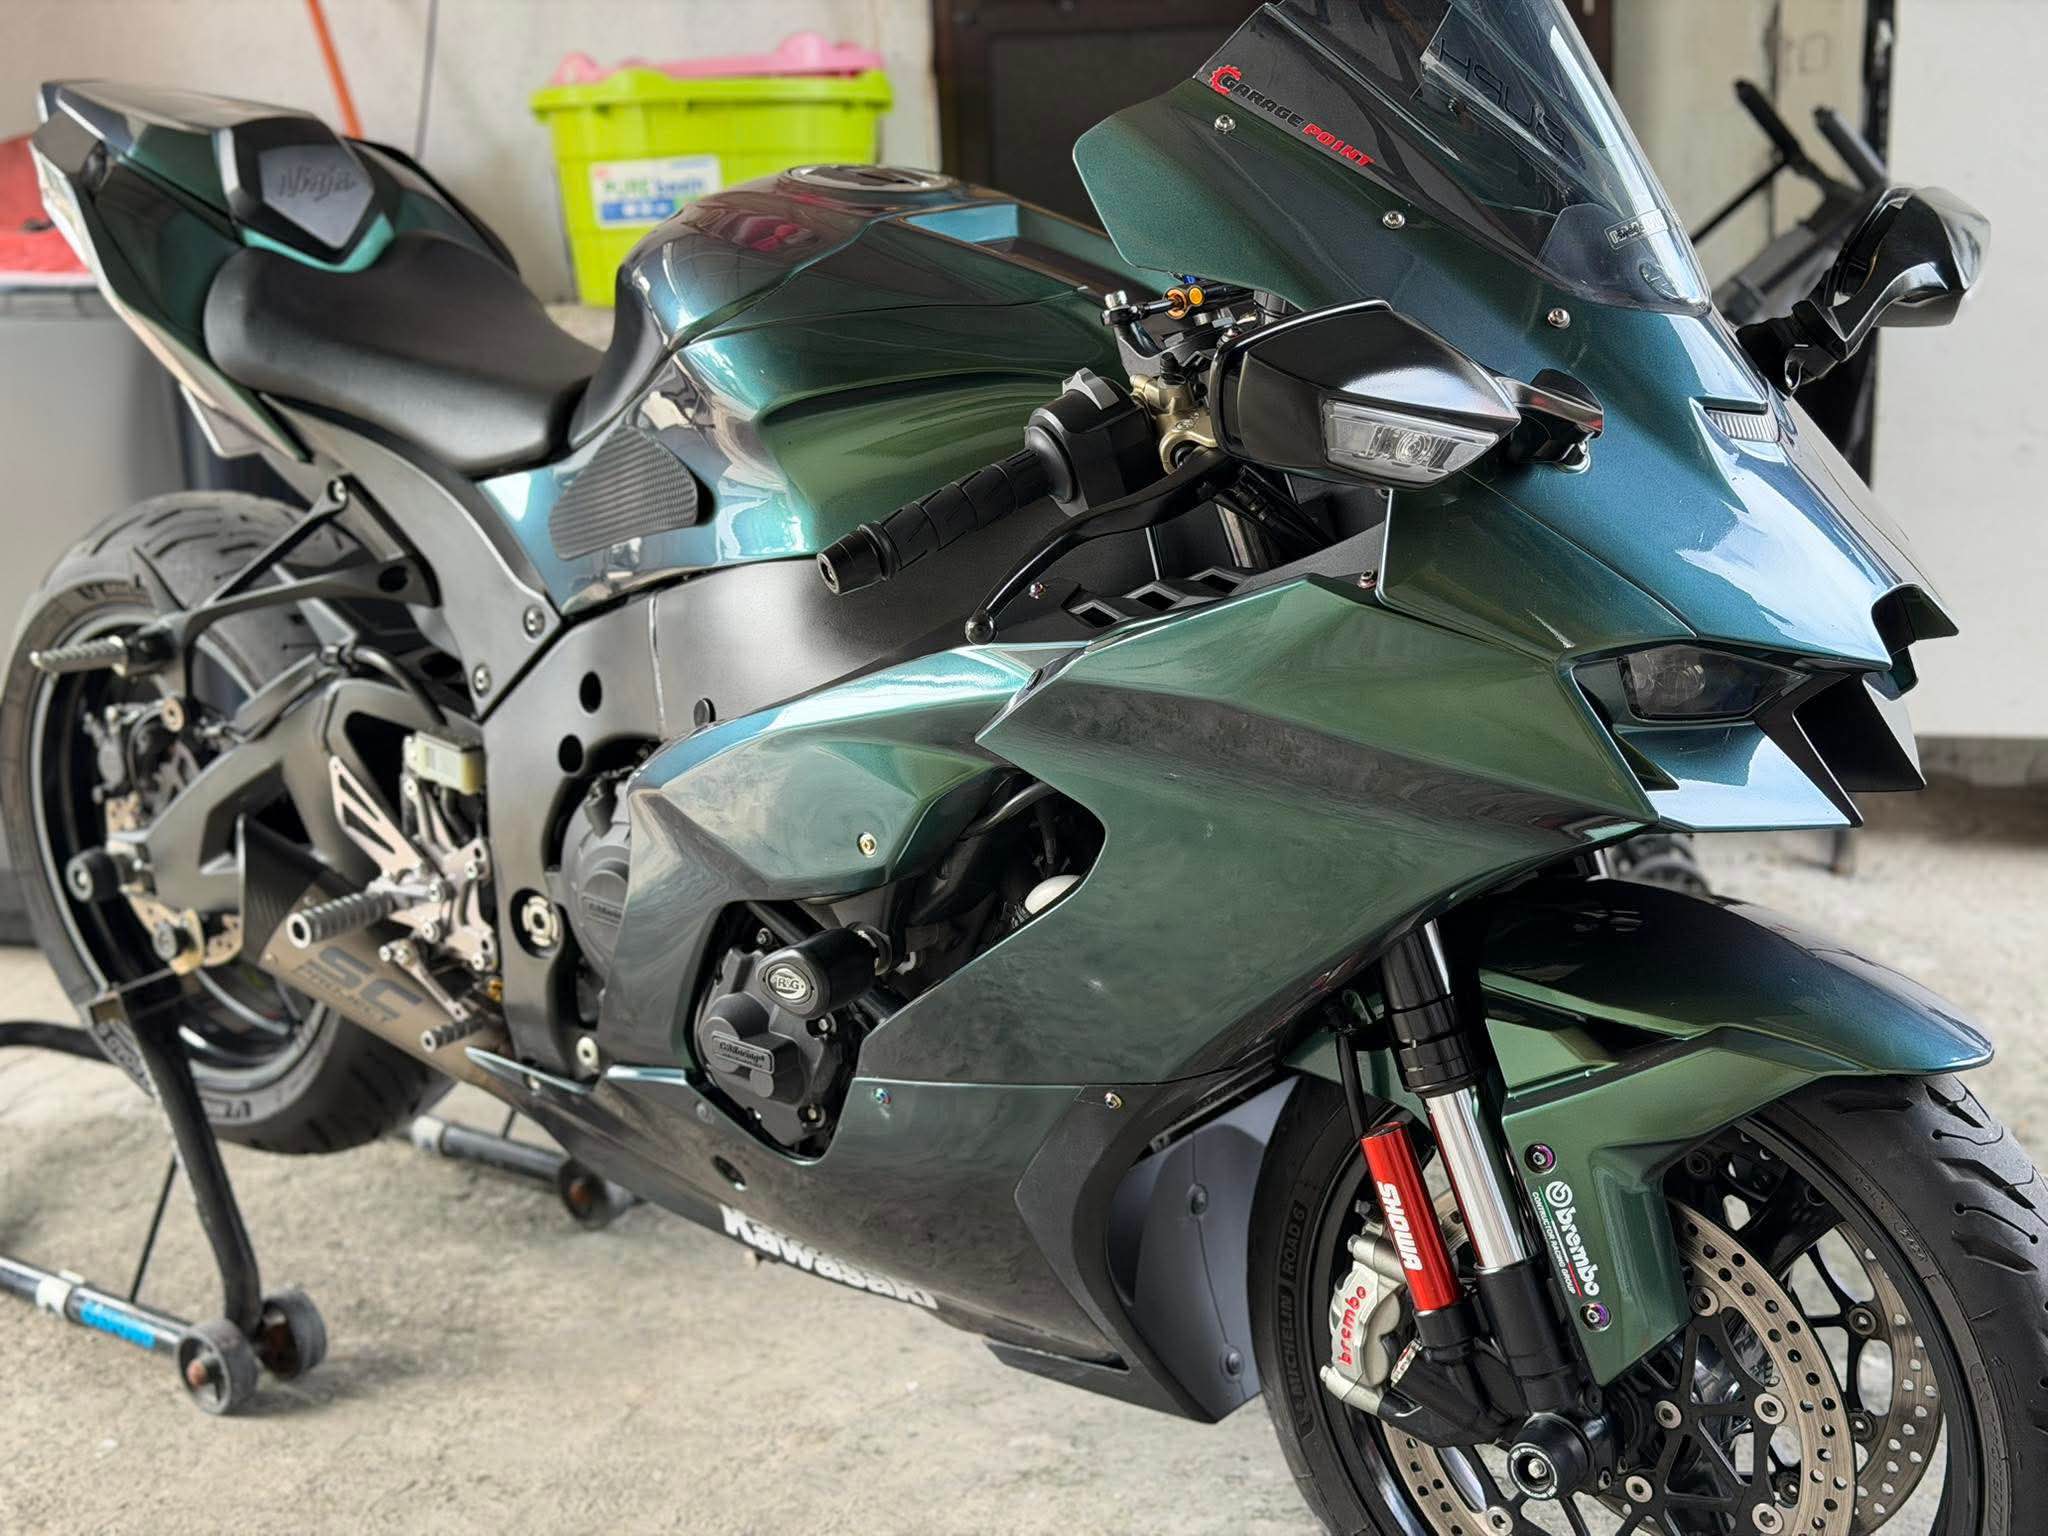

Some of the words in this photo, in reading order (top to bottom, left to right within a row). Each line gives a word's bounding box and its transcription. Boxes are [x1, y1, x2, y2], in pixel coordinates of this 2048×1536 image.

[1218, 72, 1305, 128] GARAGE
[1303, 122, 1376, 168] POINT
[279, 164, 358, 203] Ninja
[718, 1203, 939, 1311] Kawasaki
[1282, 1226, 1301, 1275] ROAD
[1377, 1181, 1424, 1271] SHOWA
[1551, 1240, 1566, 1268] RACING
[1561, 1268, 1577, 1295] GROUP
[1555, 1206, 1600, 1296] brembo
[1338, 1285, 1367, 1366] brembo
